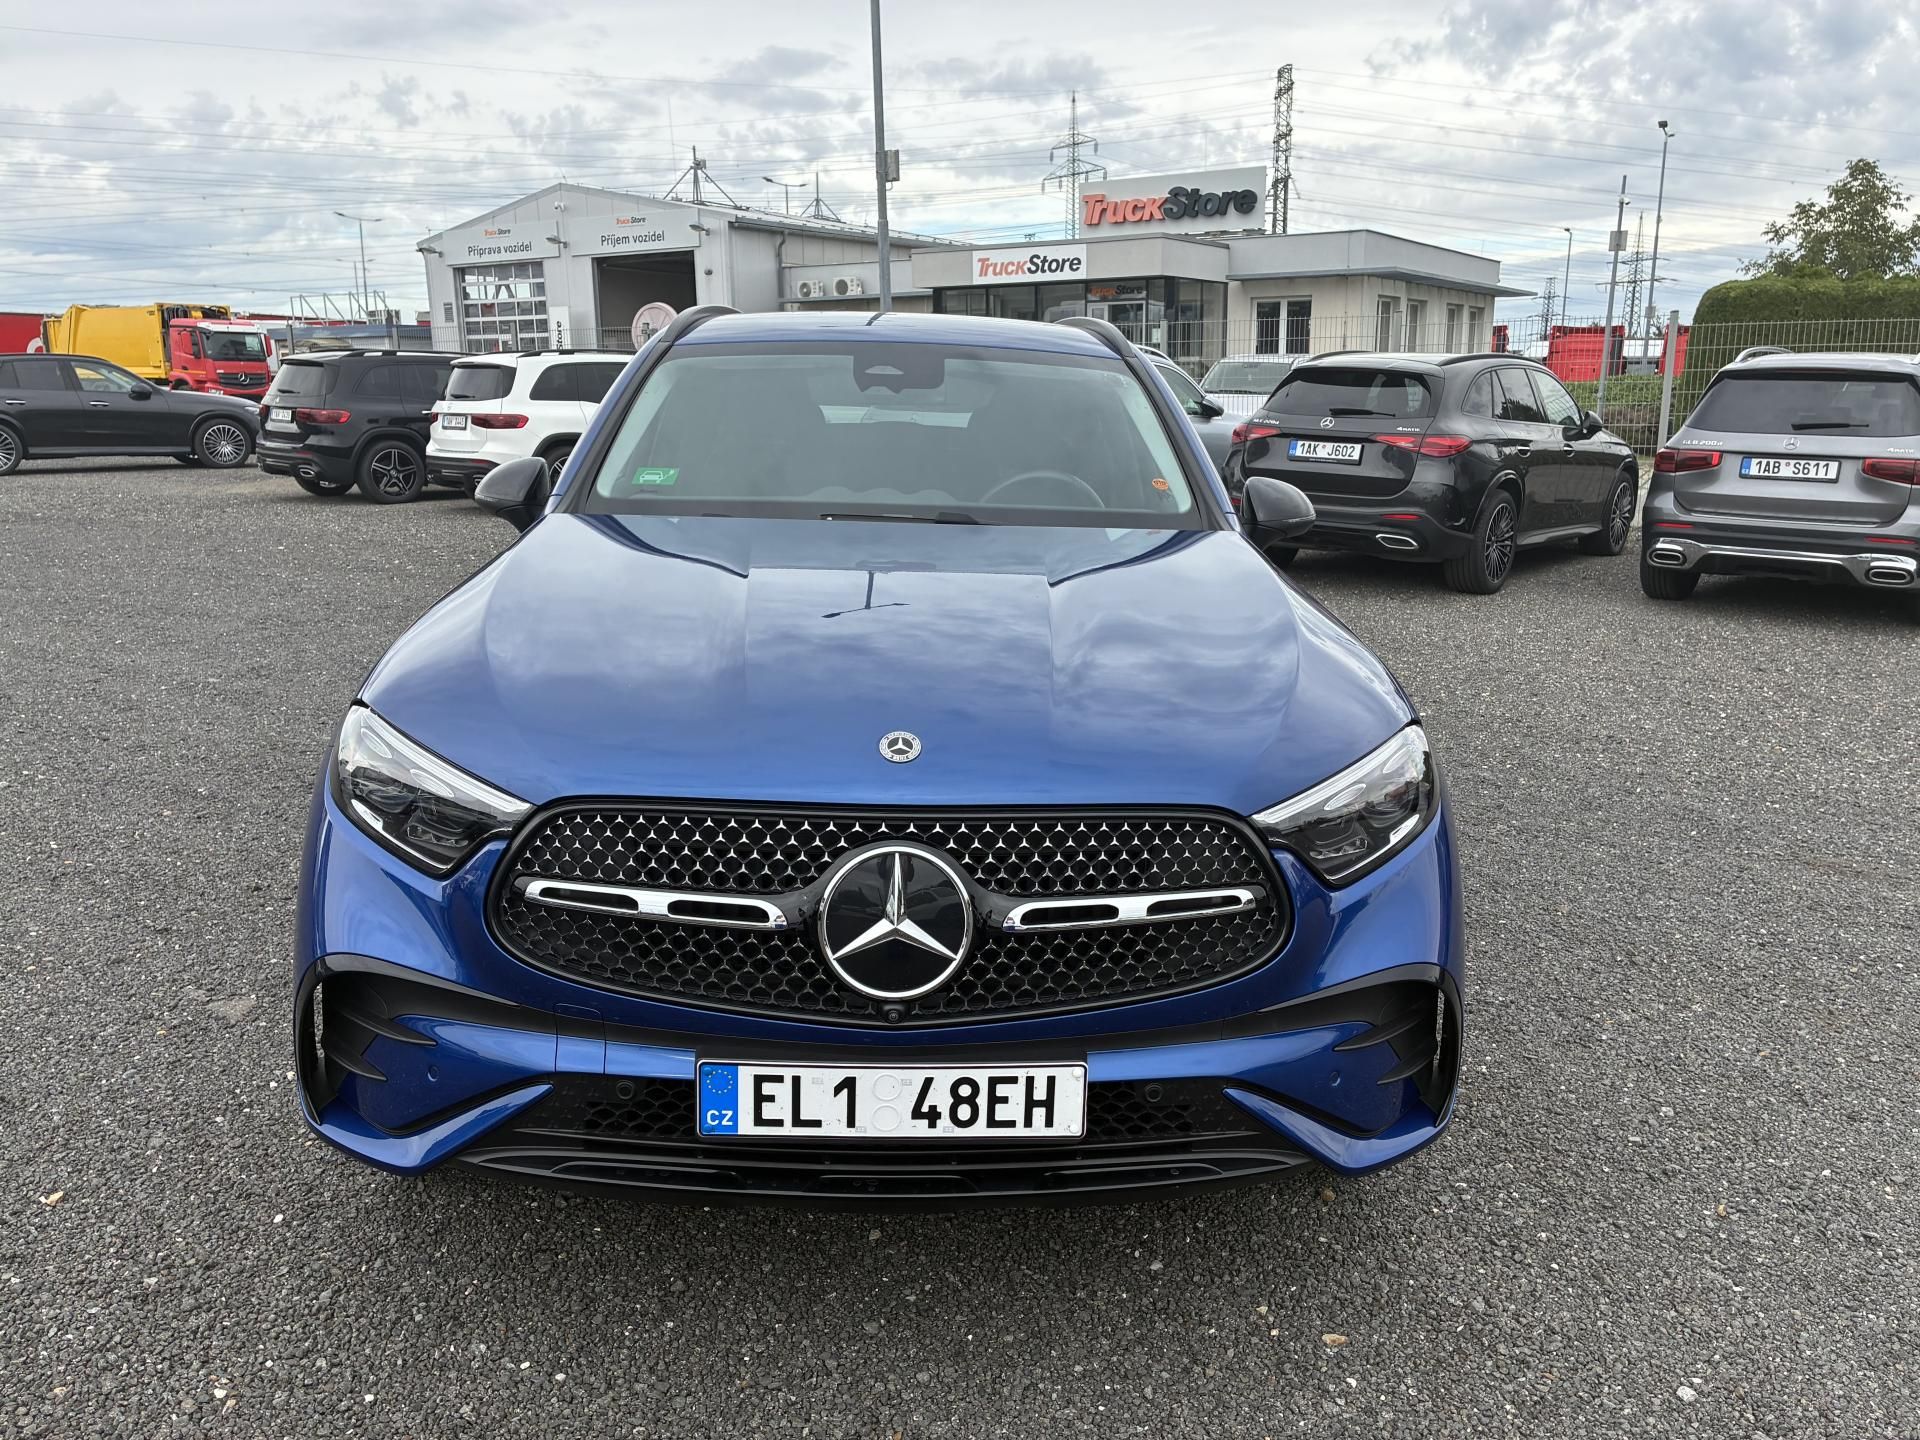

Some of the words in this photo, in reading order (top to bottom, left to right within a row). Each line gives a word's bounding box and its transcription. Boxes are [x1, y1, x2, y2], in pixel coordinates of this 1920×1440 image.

[1083, 186, 1258, 226] TruckStore
[600, 233, 630, 248] Příjem
[632, 229, 665, 244] vozidel
[467, 245, 502, 259] Příprava
[503, 241, 533, 254] vozidel
[977, 253, 1082, 278] TruckStore
[1300, 442, 1320, 456] 1AK
[1327, 444, 1356, 458] J602
[1755, 460, 1781, 474] 1AB
[1792, 461, 1830, 477] S611
[753, 1074, 857, 1129] EL1
[911, 1075, 1056, 1129] 48EH
[706, 1109, 733, 1126] CZ
